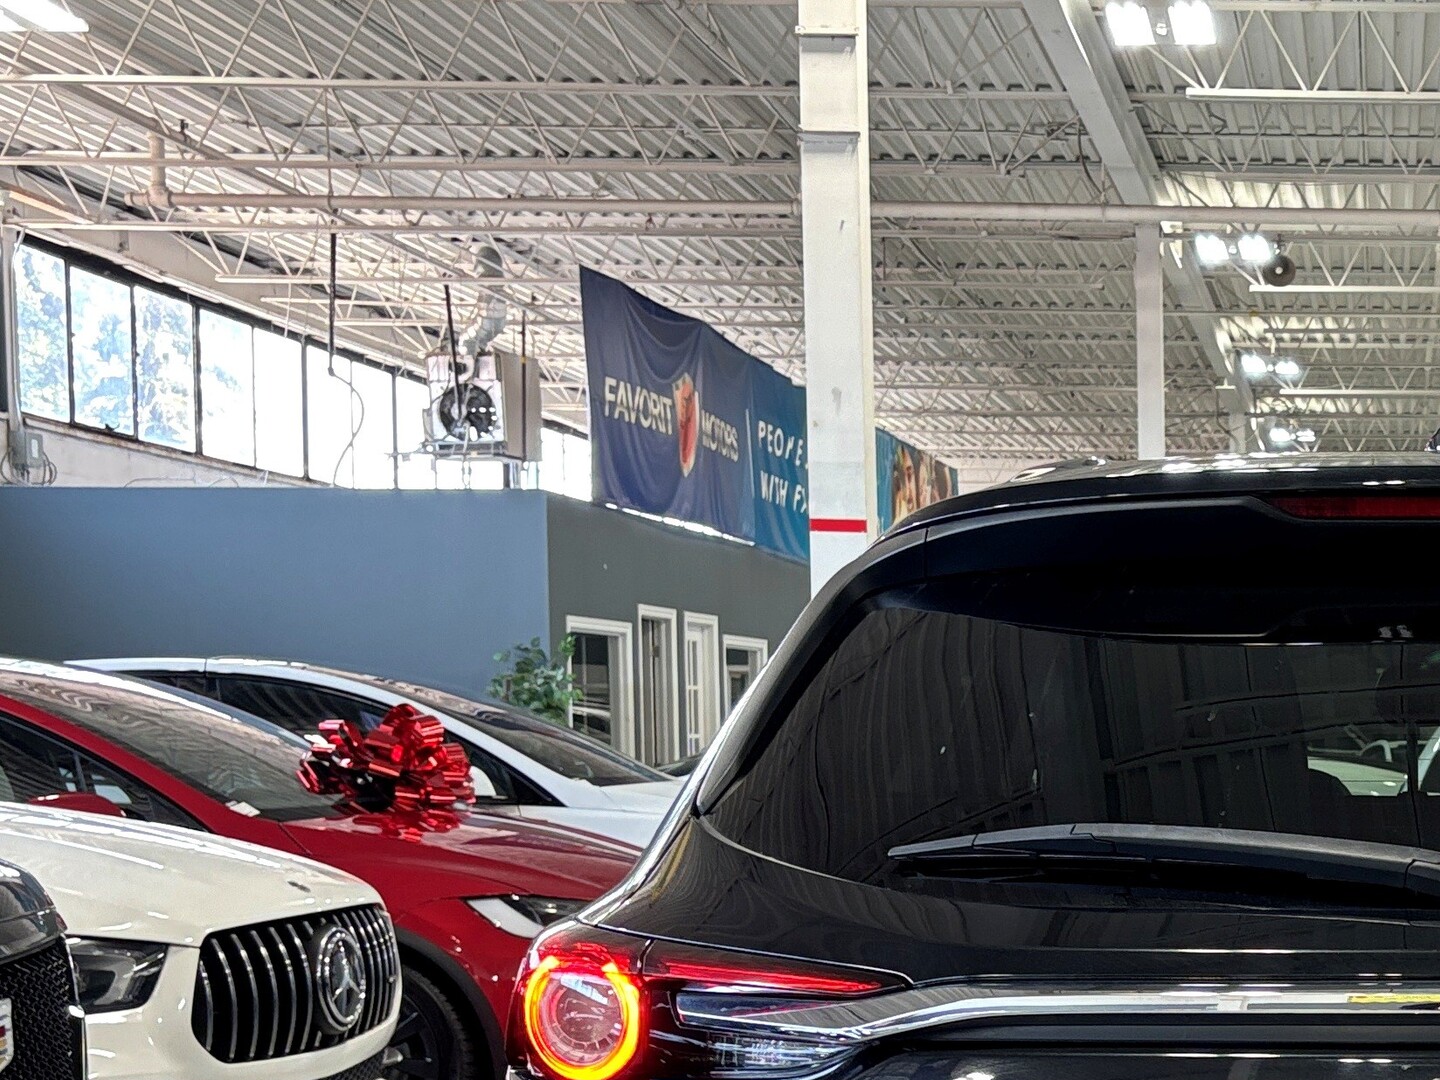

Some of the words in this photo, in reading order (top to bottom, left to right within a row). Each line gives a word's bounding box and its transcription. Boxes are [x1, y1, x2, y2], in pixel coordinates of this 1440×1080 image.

[604, 376, 673, 435] FAVORIT
[701, 408, 739, 463] MOTORS
[758, 420, 804, 467] PEOPE
